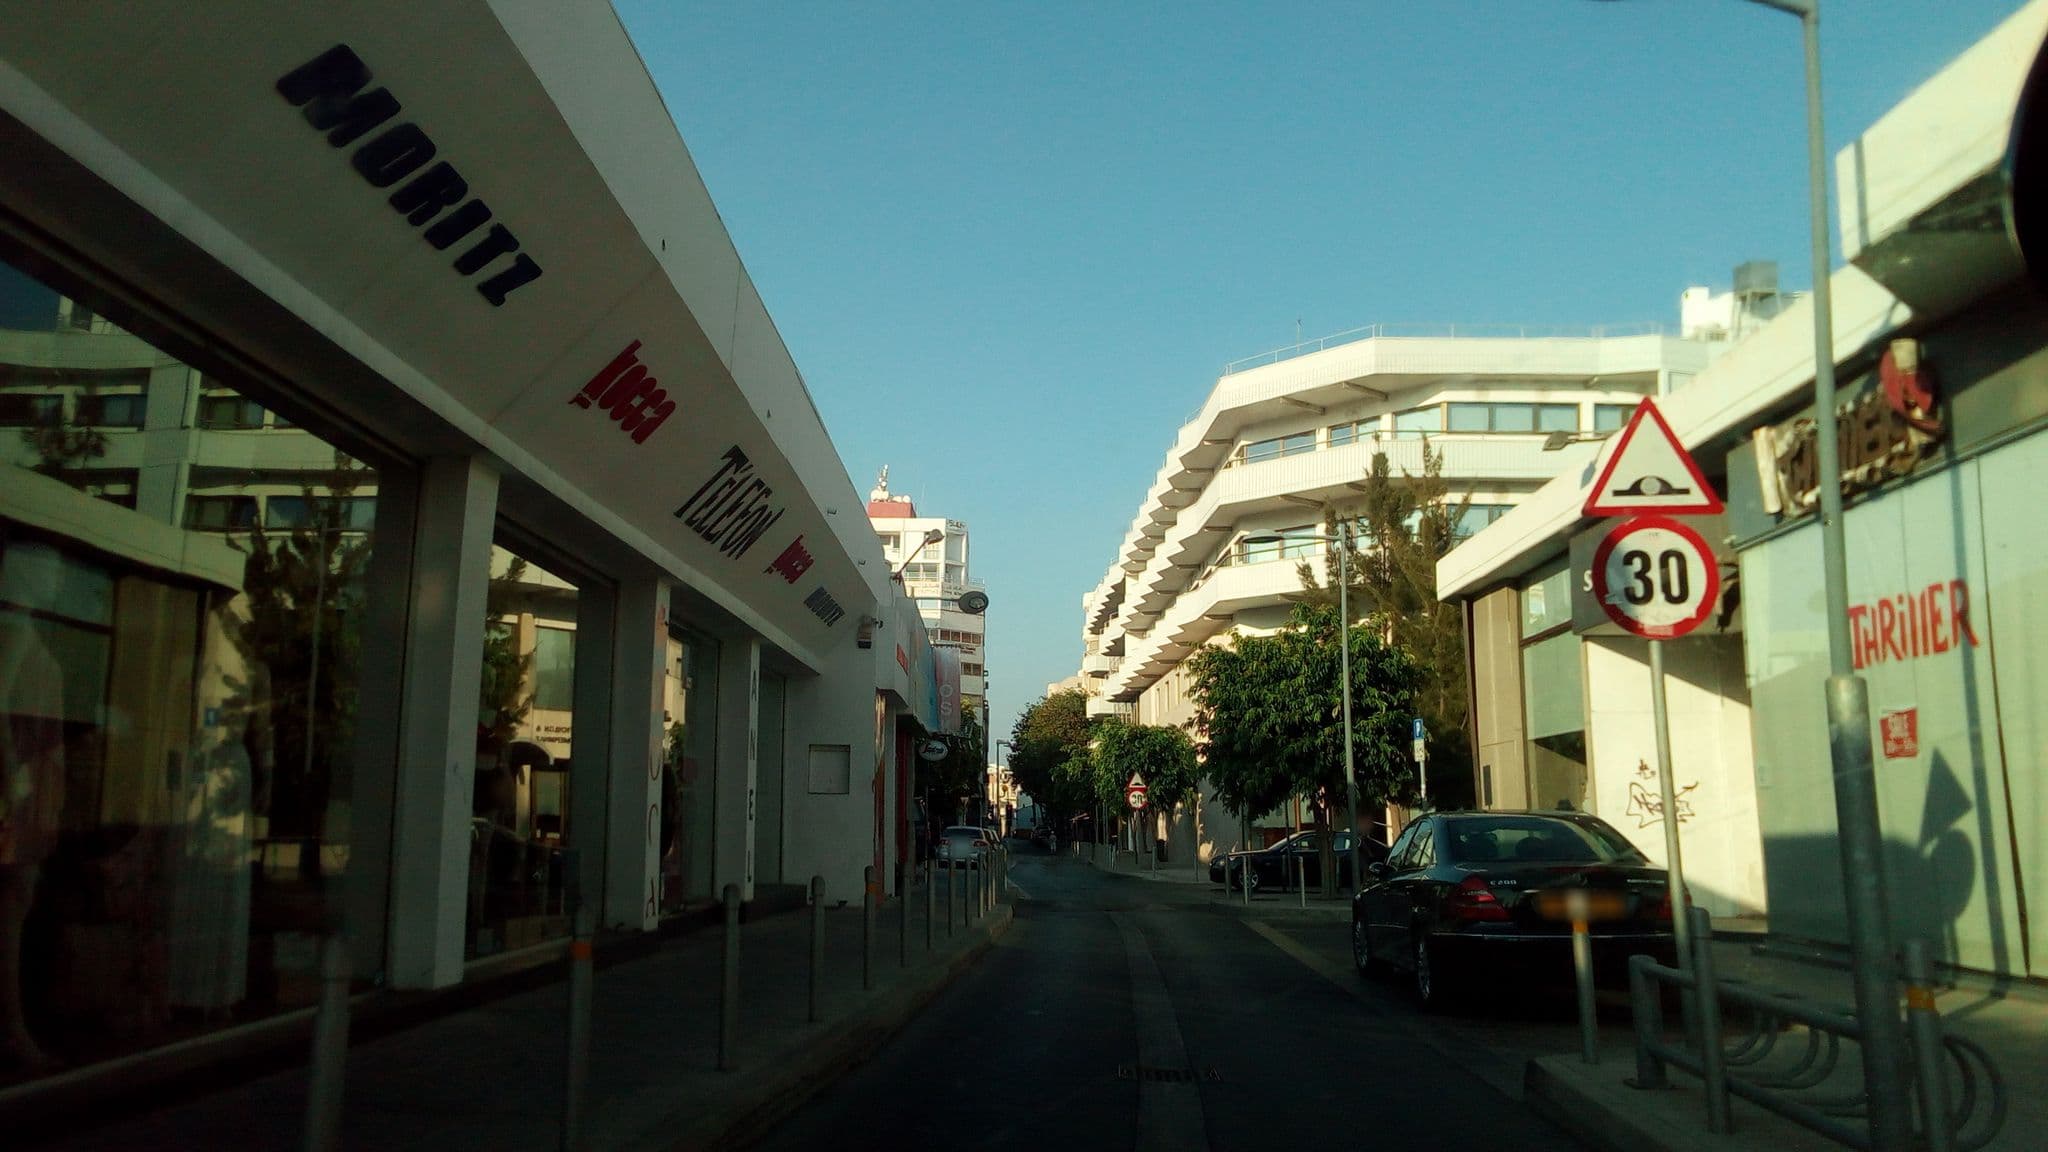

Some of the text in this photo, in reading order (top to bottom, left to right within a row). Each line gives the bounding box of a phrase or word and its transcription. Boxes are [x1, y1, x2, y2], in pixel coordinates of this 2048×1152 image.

[276, 43, 543, 307] MORITZ
[1622, 548, 1690, 606] 30
[1131, 793, 1143, 805] 30
